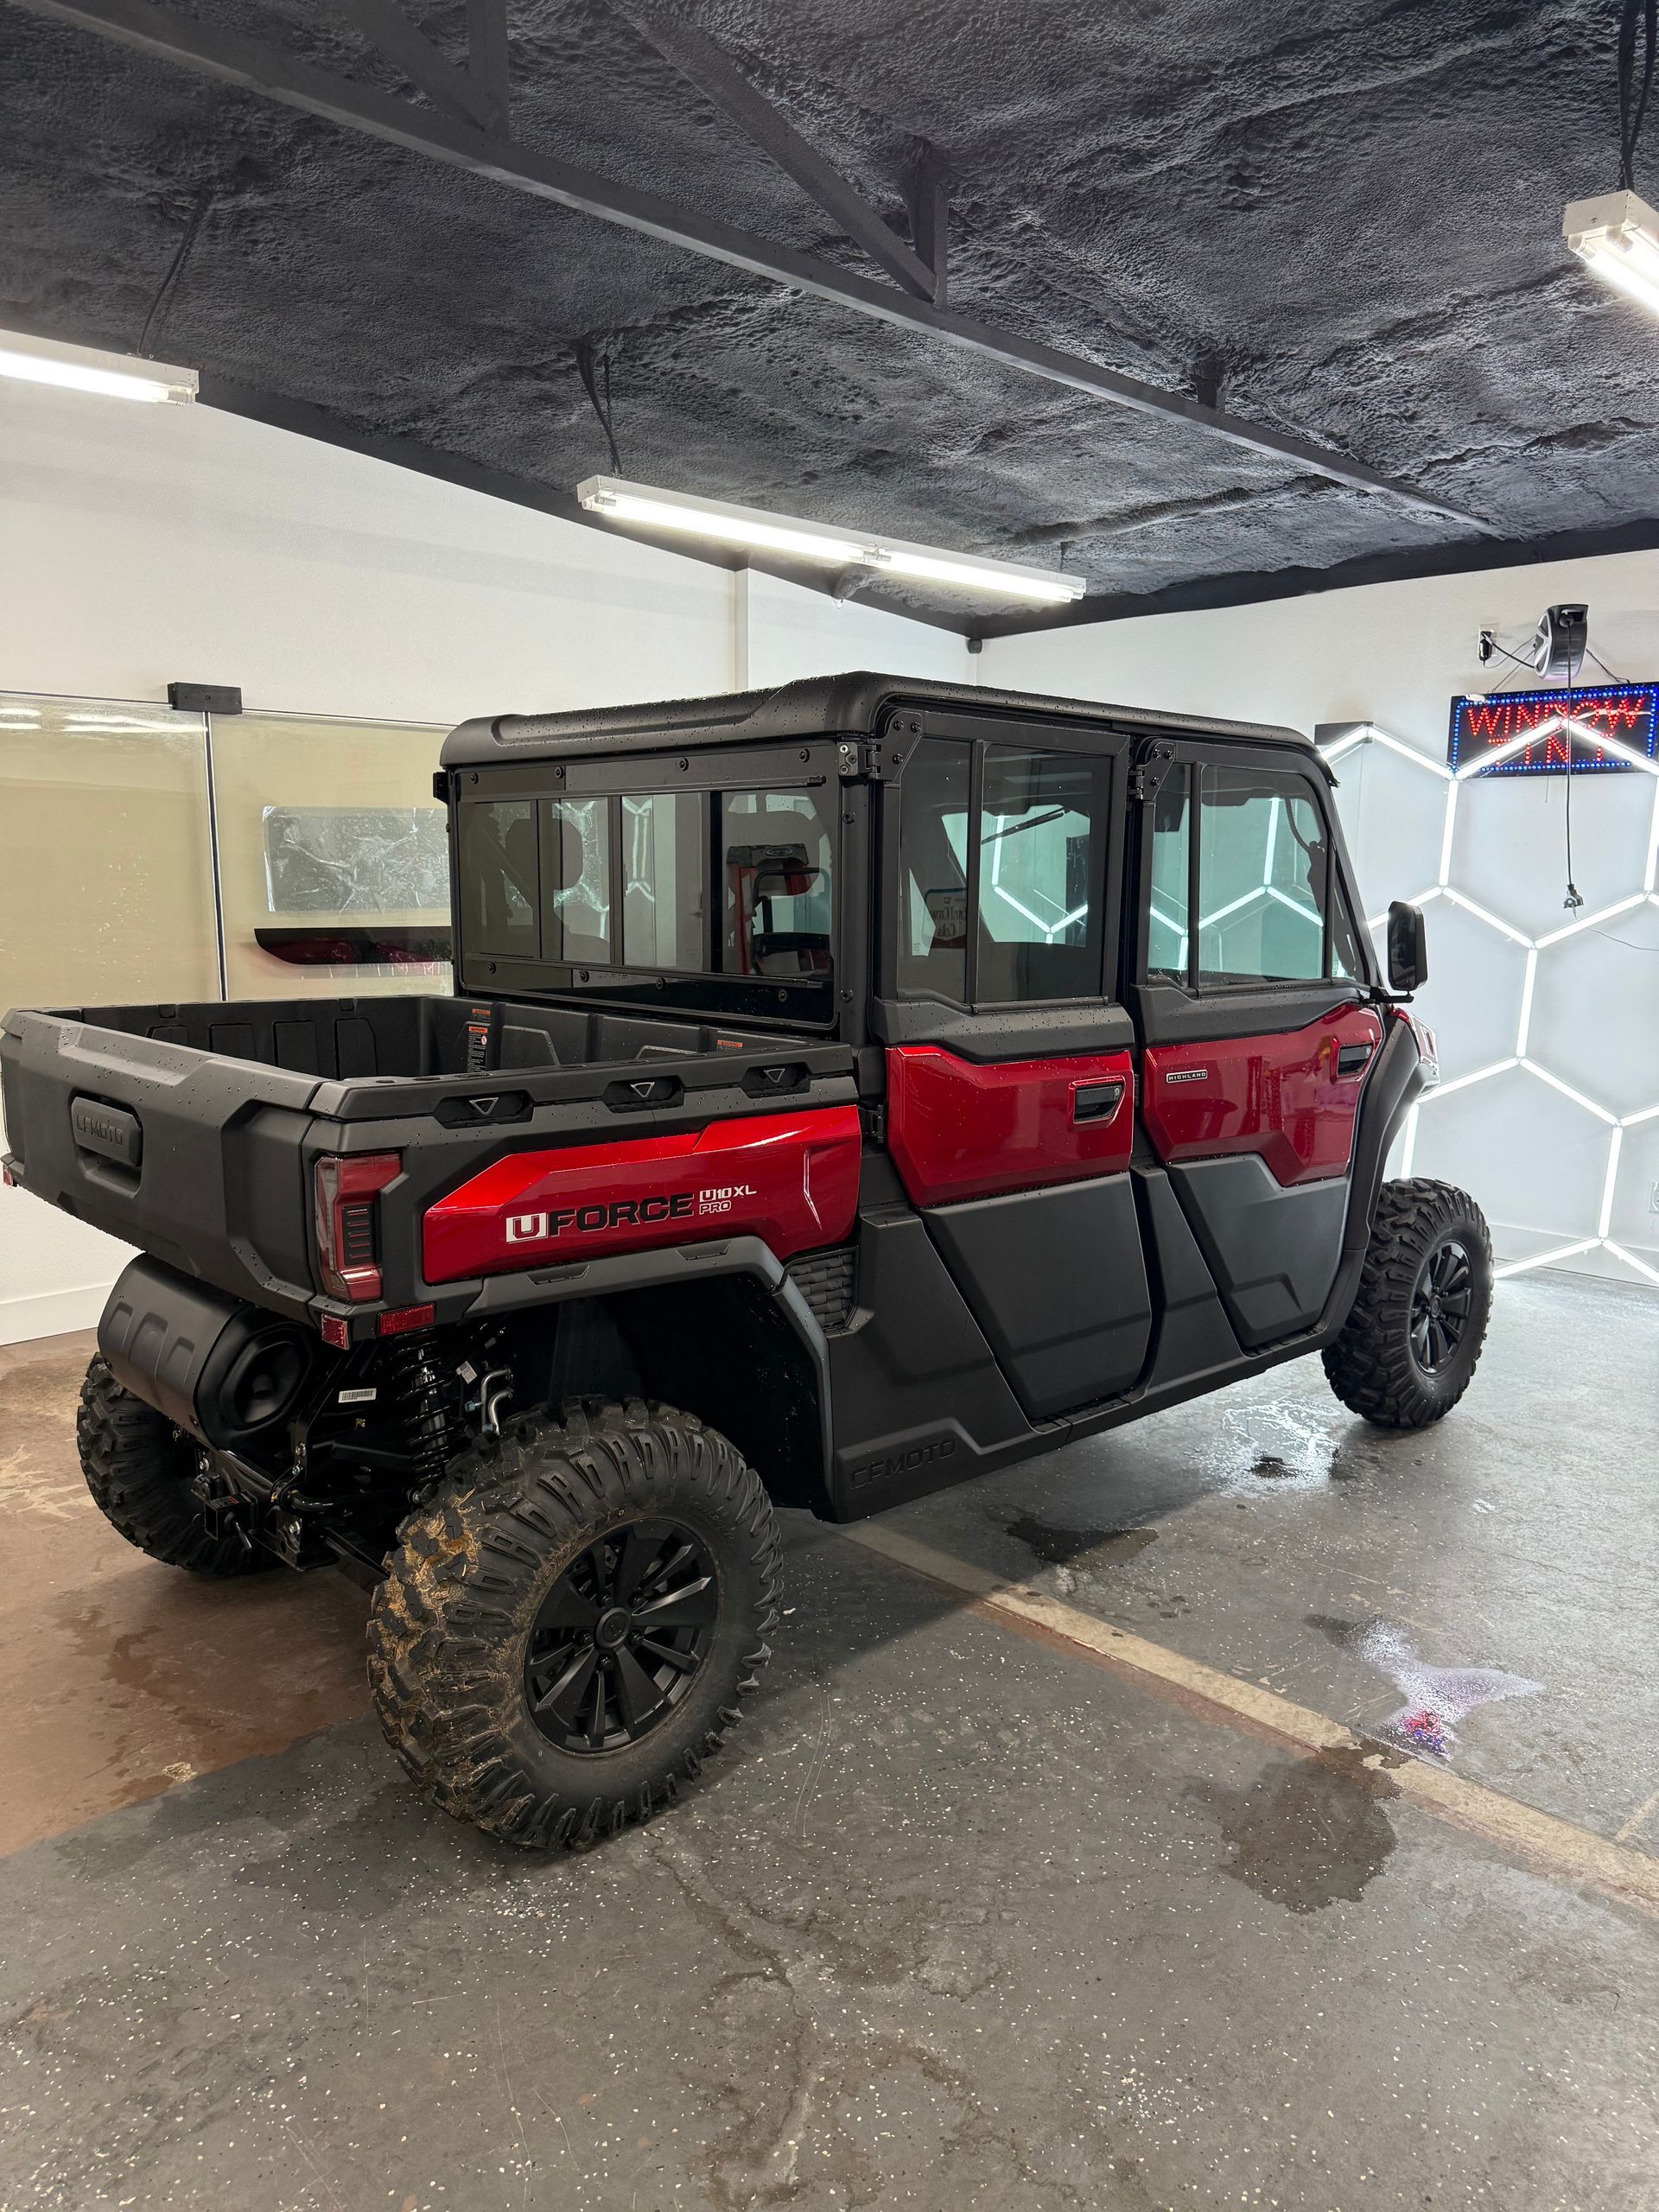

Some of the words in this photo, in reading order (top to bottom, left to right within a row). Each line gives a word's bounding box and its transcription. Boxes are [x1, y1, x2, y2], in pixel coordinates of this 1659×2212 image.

[1168, 1071, 1206, 1081] HIGHLAND
[699, 1200, 732, 1216] PRO
[850, 1438, 957, 1490] CFMOTO
